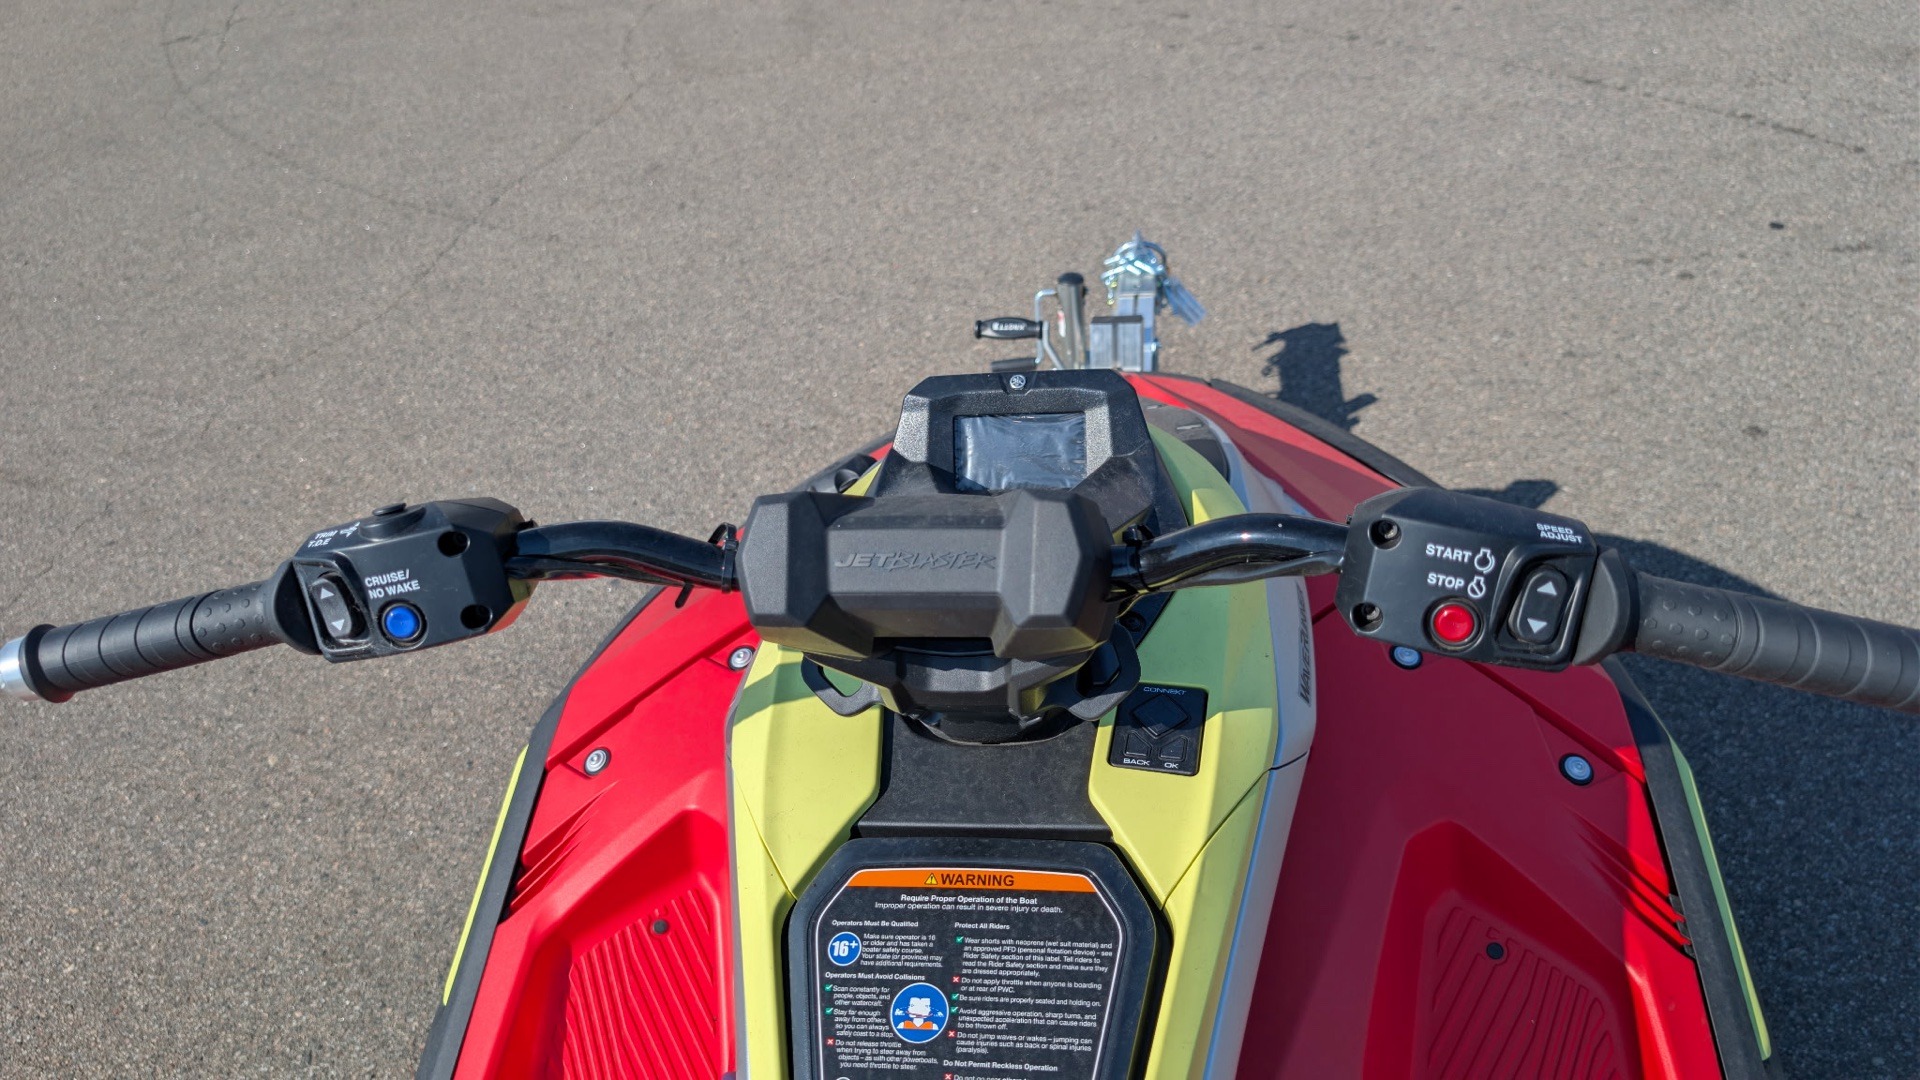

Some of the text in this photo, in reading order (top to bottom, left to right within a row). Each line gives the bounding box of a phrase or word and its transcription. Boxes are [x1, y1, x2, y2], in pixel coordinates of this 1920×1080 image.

[314, 530, 337, 540] TRIM
[1536, 524, 1574, 534] SPEED
[1540, 531, 1582, 543] ADJUST
[1426, 544, 1472, 562] START
[364, 568, 410, 588] CRUISE/
[1427, 573, 1465, 590] STOP
[369, 580, 420, 600] NO WAKE
[941, 874, 1014, 886] WARNING
[901, 894, 929, 903] Require
[931, 894, 955, 904] Proper
[958, 895, 994, 905] Operation
[875, 902, 906, 910] Improper
[908, 902, 940, 911] operation
[1011, 905, 1029, 913] injury
[832, 919, 862, 928] Operators
[981, 952, 1000, 961] Safety
[1006, 961, 1024, 970] Safety
[1095, 965, 1108, 973] they
[825, 971, 856, 980] Operators
[983, 977, 1000, 986] apply
[1074, 981, 1102, 990] boarding
[1010, 996, 1034, 1005] properly
[1069, 999, 1090, 1008] holding
[978, 1009, 1011, 1017] aggressive
[1046, 1011, 1063, 1020] sharp
[1053, 1036, 1079, 1045] jumping
[992, 1061, 1022, 1070] Reckless
[1024, 1063, 1058, 1073] Operation
